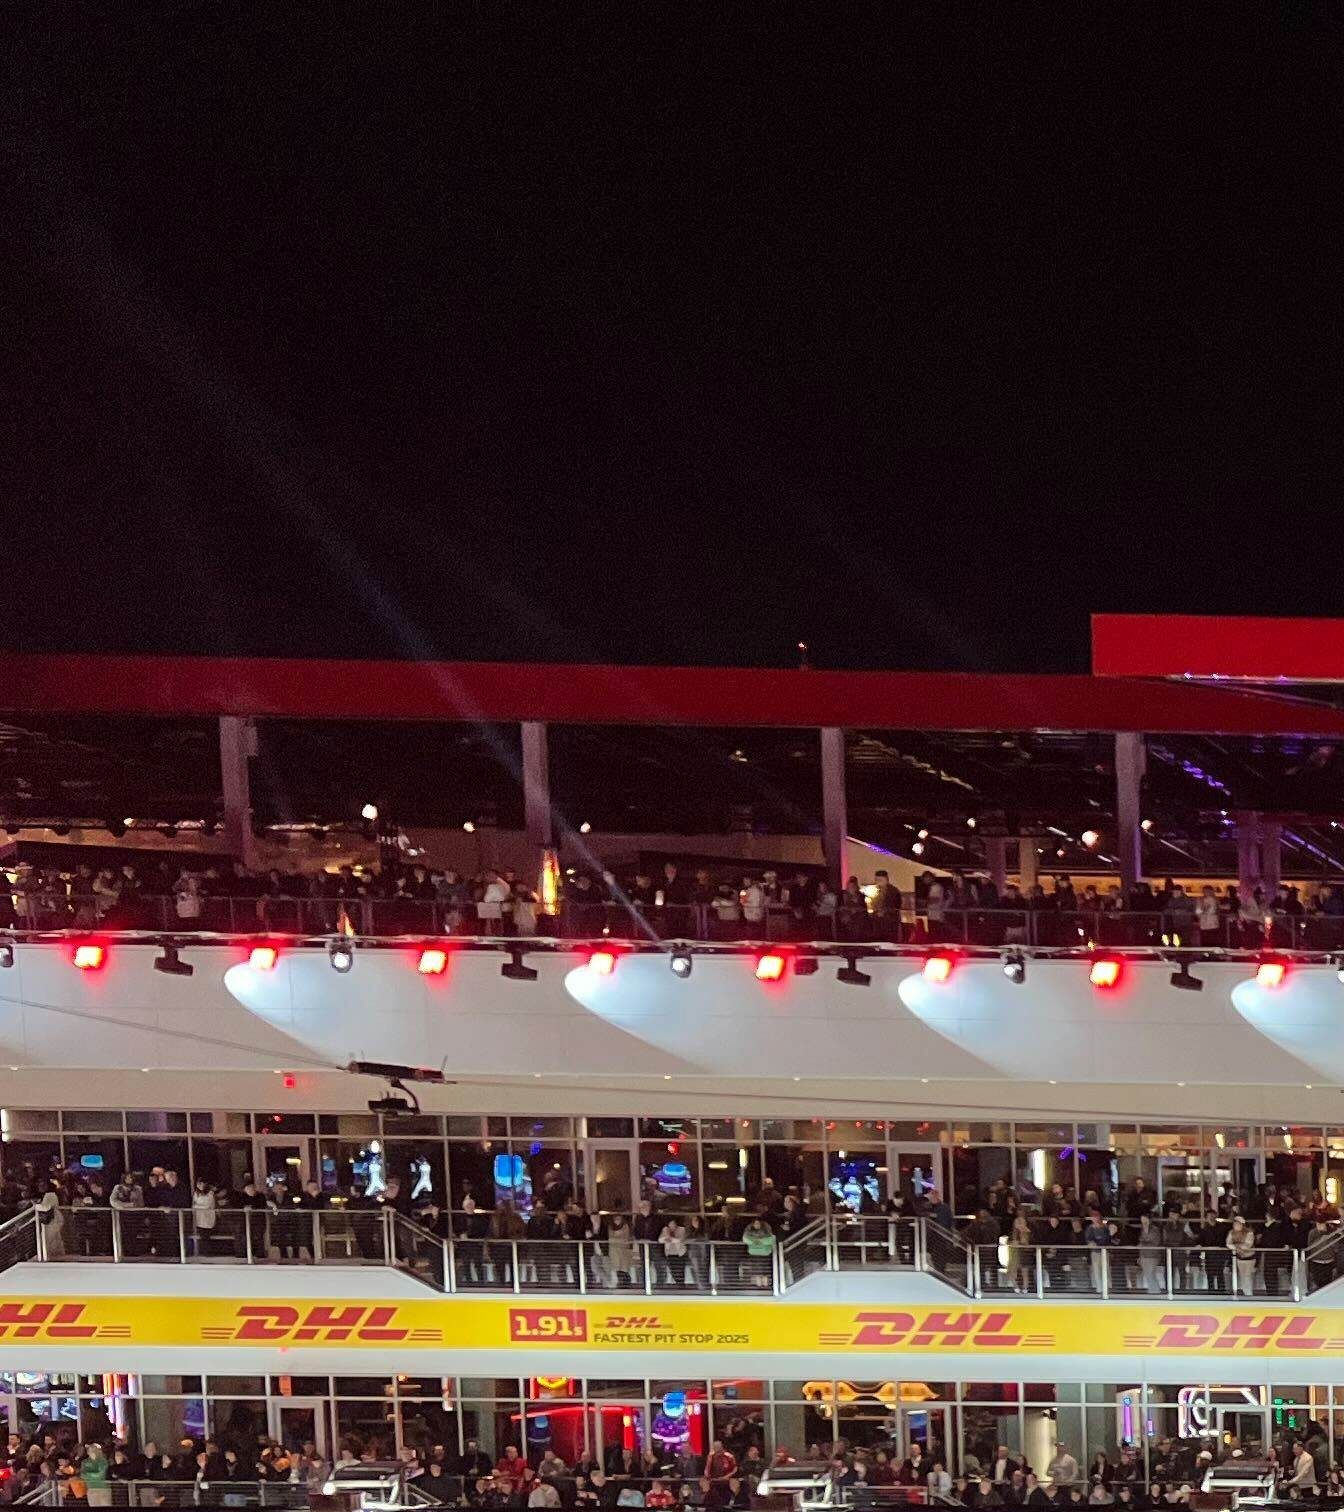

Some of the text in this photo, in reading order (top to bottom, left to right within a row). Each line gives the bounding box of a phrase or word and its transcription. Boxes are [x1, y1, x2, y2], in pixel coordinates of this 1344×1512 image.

[235, 1306, 410, 1341] DHL
[594, 1333, 749, 1344] FASTEST PIT STOP 2025
[605, 1316, 662, 1329] DHL
[853, 1312, 1022, 1346] DHL
[1155, 1314, 1325, 1349] DHL
